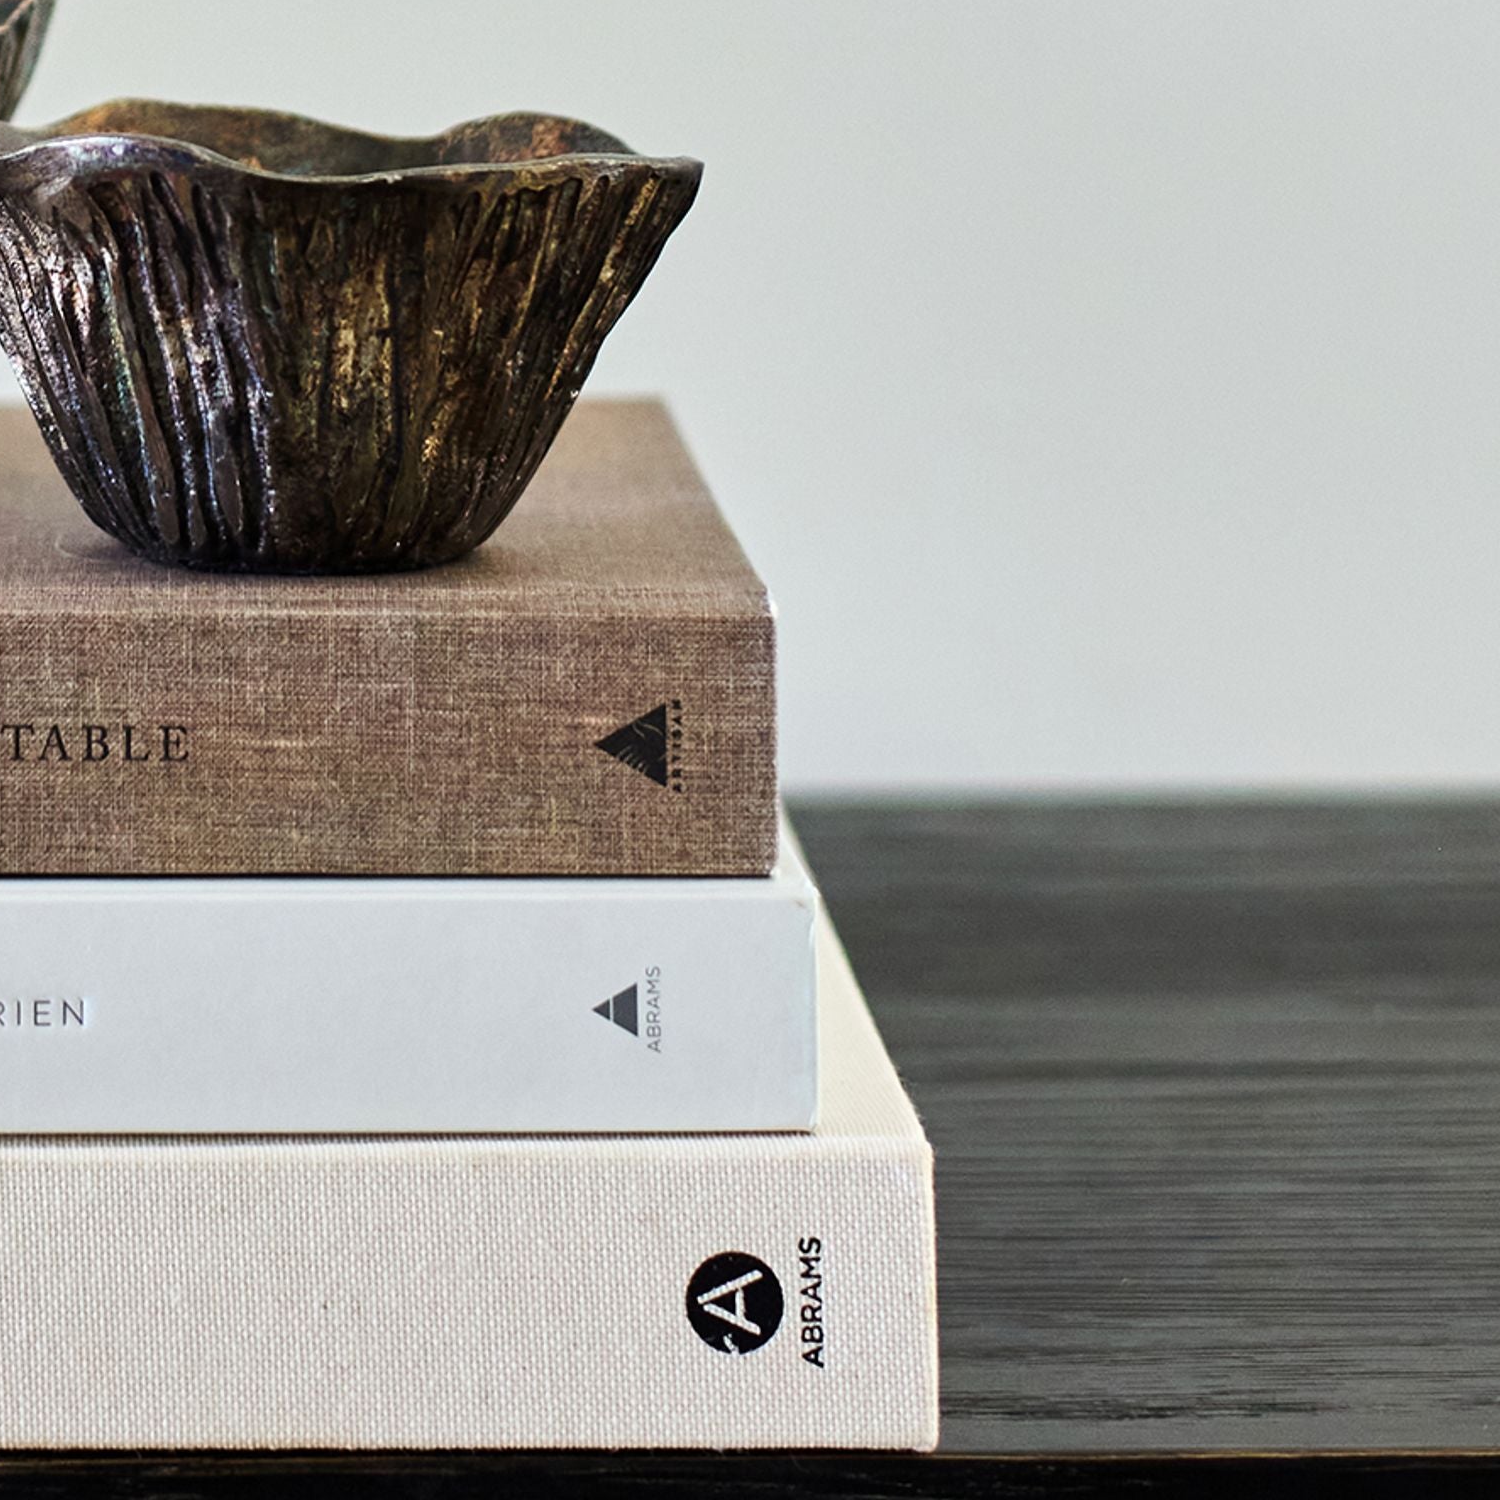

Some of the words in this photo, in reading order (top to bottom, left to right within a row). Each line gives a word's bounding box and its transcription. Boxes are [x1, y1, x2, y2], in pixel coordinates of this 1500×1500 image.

[0, 722, 190, 763] TABLE
[645, 965, 661, 1054] ABRAMS
[797, 1236, 826, 1370] ABRAMS
